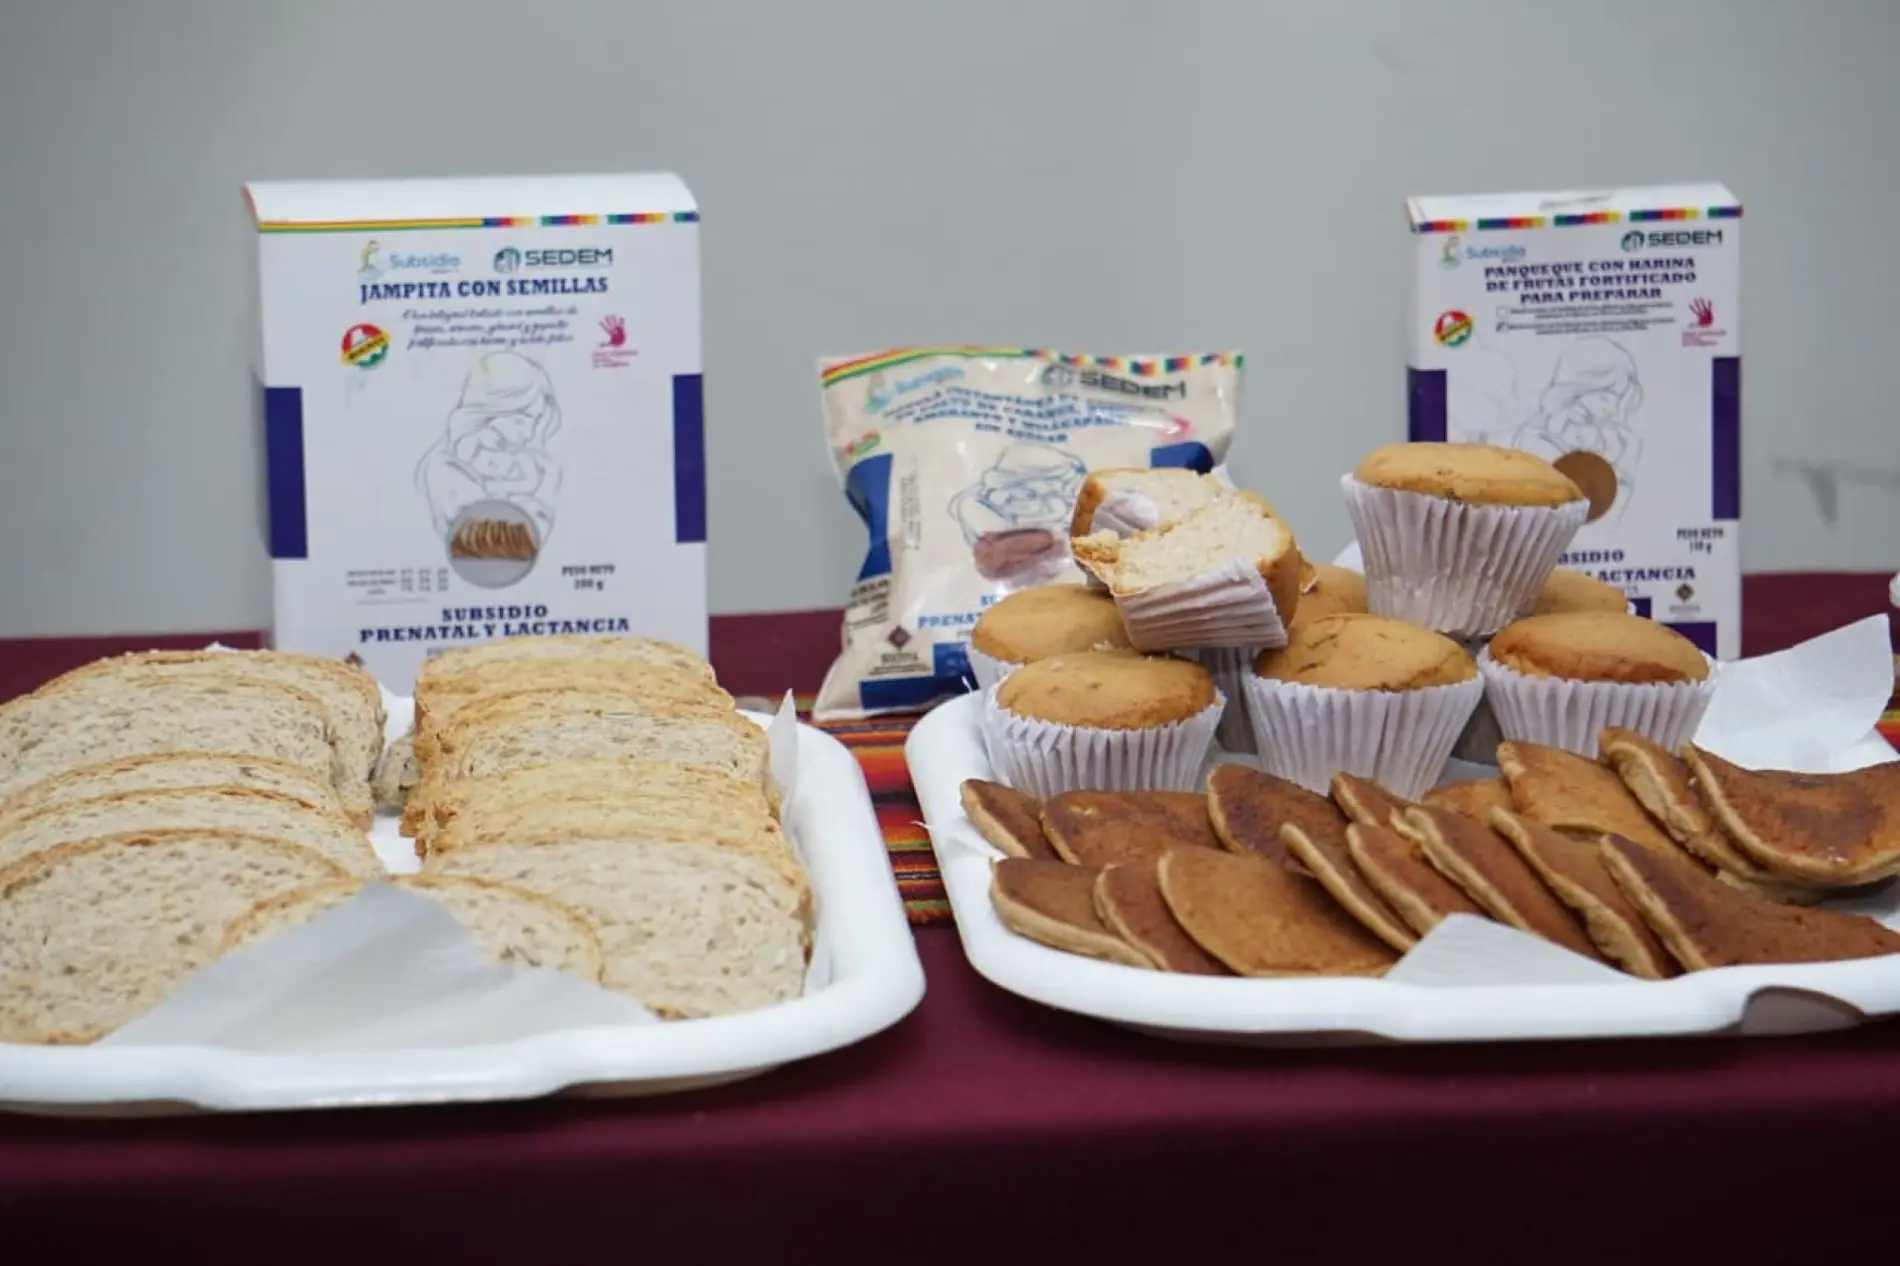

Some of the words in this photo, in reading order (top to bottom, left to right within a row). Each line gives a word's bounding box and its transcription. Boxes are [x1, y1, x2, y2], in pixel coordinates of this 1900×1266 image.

[1648, 230, 1723, 247] SEDEM
[525, 248, 613, 266] SEDEM
[1484, 261, 1583, 279] PANQUEQUE
[1588, 259, 1625, 273] CON
[1629, 257, 1695, 270] HARINA
[360, 281, 450, 304] JAMPITA
[457, 280, 500, 297] CON
[507, 277, 608, 295] SEMILLAS
[1486, 279, 1508, 292] DE
[1512, 276, 1575, 291] FRUTAS
[1579, 272, 1696, 287] FORTIFICADO
[1520, 291, 1564, 304] PARA
[1568, 288, 1662, 302] PREPARAR
[1079, 370, 1187, 399] SEDEM
[589, 563, 616, 576] NETO
[1585, 566, 1695, 583] ACTANCIA
[442, 604, 548, 622] SUBSIDIO
[359, 625, 479, 643] PRENATAL
[484, 624, 496, 638] Y
[503, 617, 630, 637] LACTANCIA
